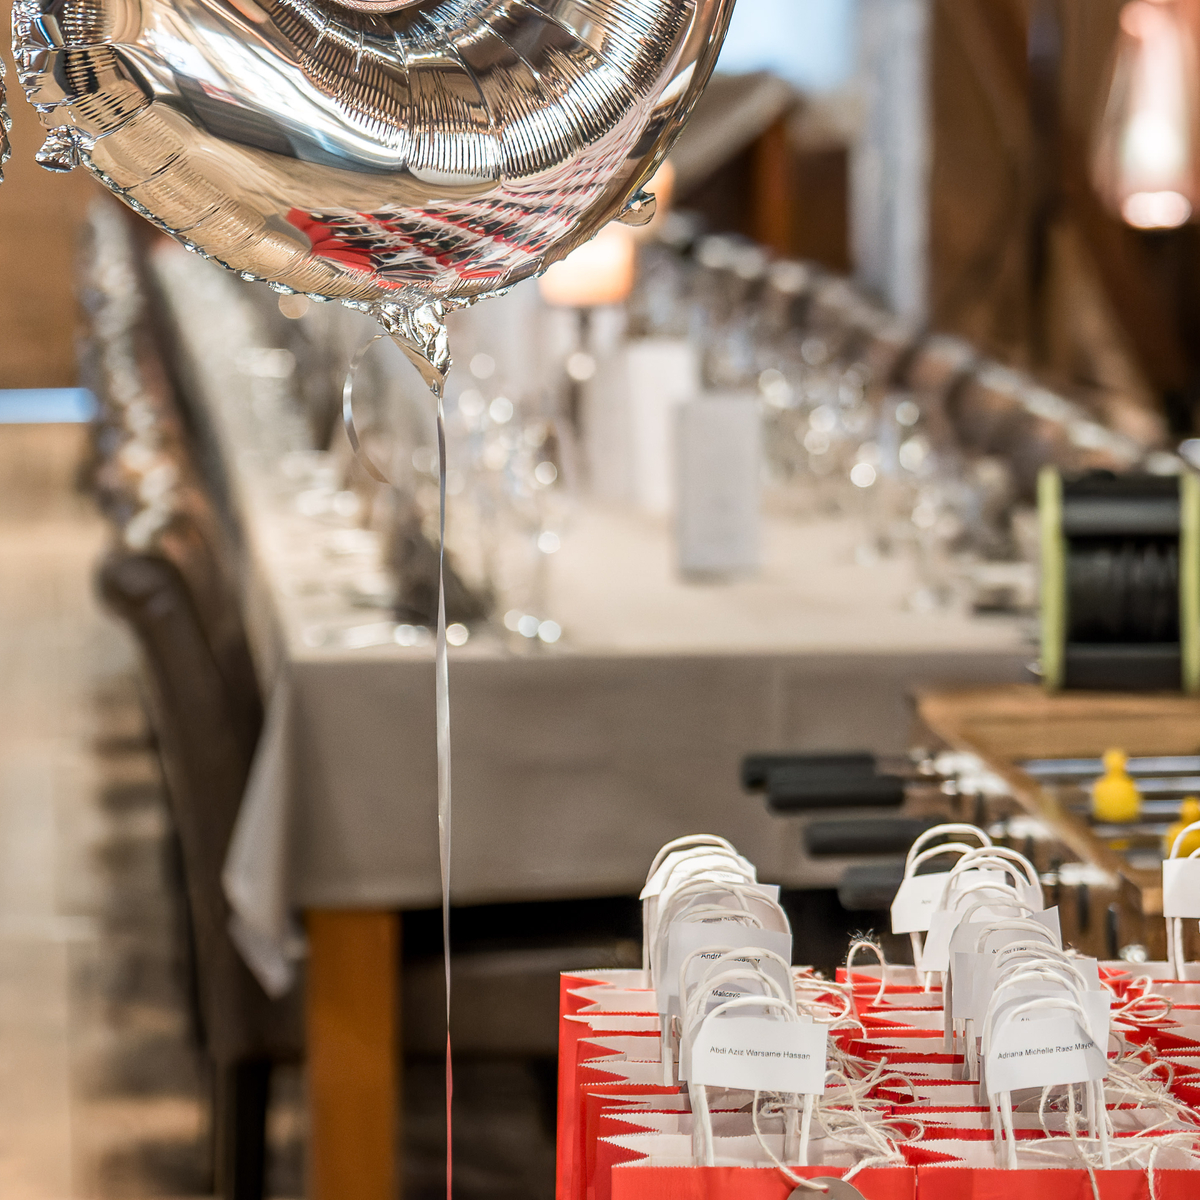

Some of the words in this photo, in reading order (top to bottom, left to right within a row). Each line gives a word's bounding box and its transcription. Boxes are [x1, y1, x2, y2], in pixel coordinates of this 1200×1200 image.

[709, 1045, 727, 1055] Abdi
[783, 1051, 811, 1060] Hassan
[998, 1050, 1023, 1060] Adriana
[1025, 1047, 1054, 1057] Michelle
